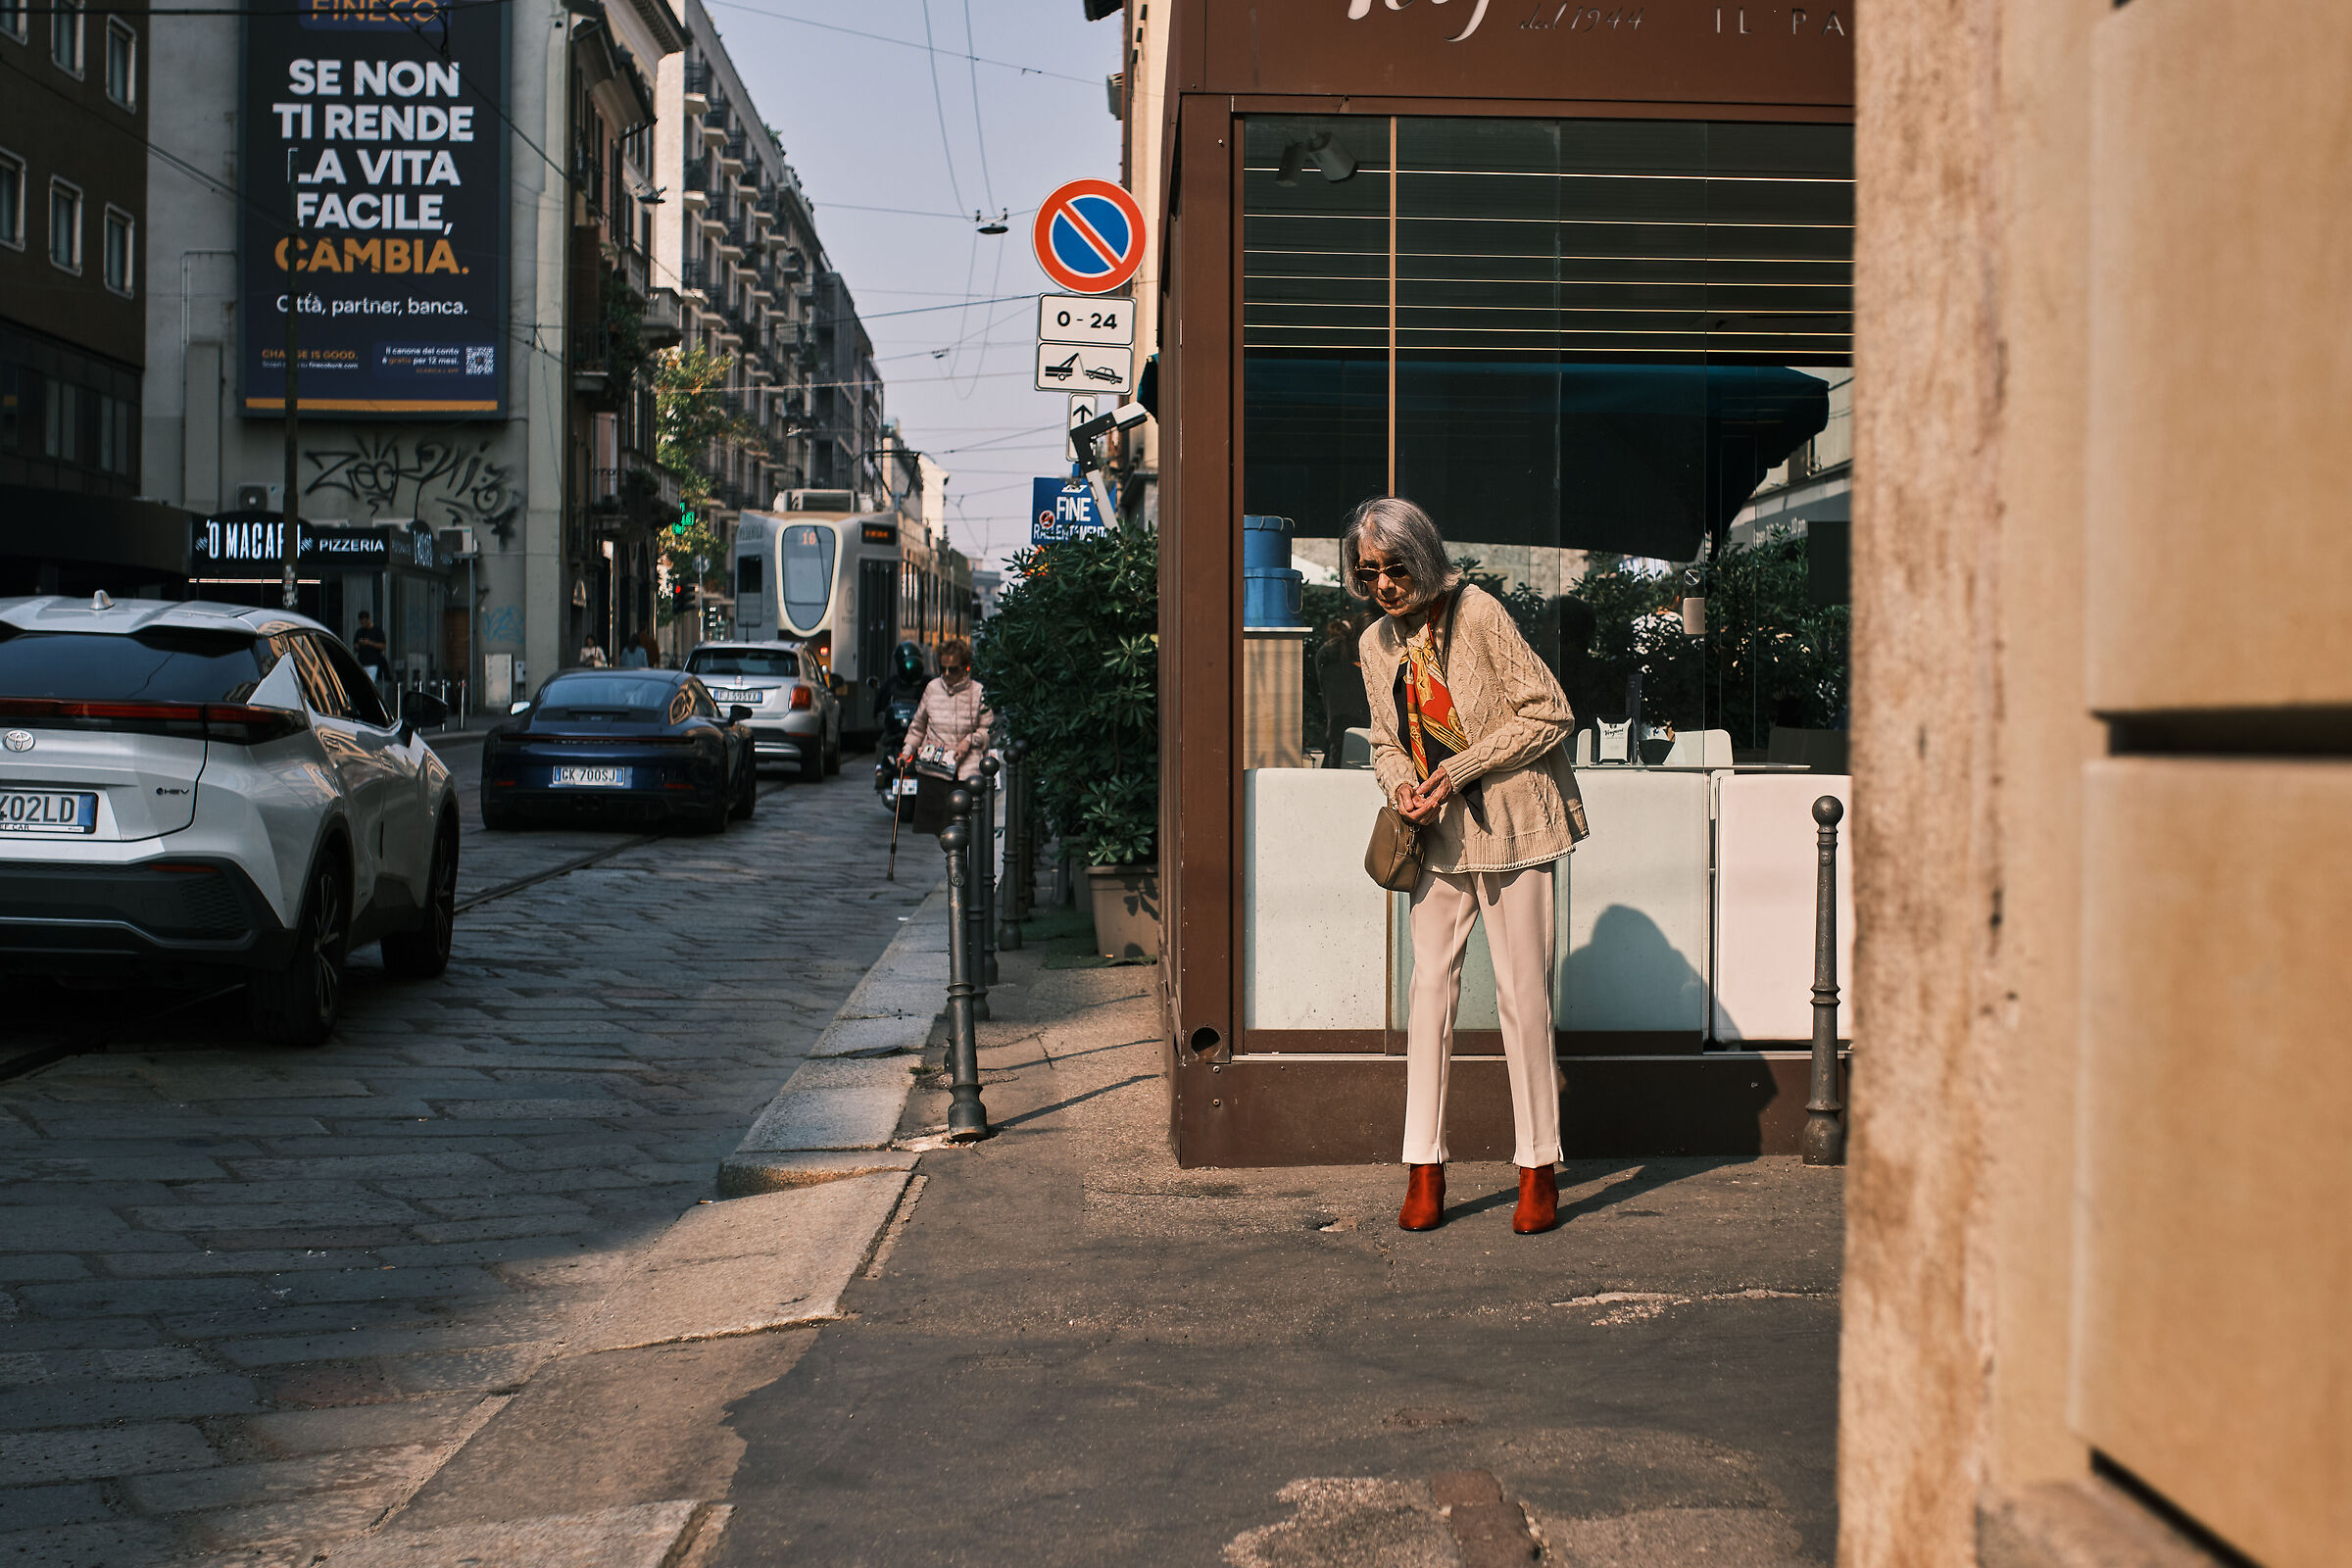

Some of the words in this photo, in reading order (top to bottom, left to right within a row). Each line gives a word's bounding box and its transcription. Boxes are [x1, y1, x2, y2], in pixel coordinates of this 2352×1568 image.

[312, 0, 438, 22] FINECO
[1571, 6, 1643, 33] 1944
[1715, 7, 1752, 35] IL
[289, 59, 342, 95] SE
[354, 60, 460, 97] NON
[272, 103, 313, 139] TI
[324, 104, 474, 142] RENDE
[287, 148, 347, 184] LA
[357, 149, 462, 186] VITA
[297, 193, 454, 235] FACILE,
[274, 236, 469, 274] CAMBIA.
[331, 297, 403, 318] partner,
[408, 296, 468, 316] banca.
[1056, 311, 1070, 327] 0
[1090, 313, 1117, 329] 24
[1056, 497, 1091, 521] FINE
[319, 538, 385, 553] PIZZERIA
[803, 532, 816, 545] 16
